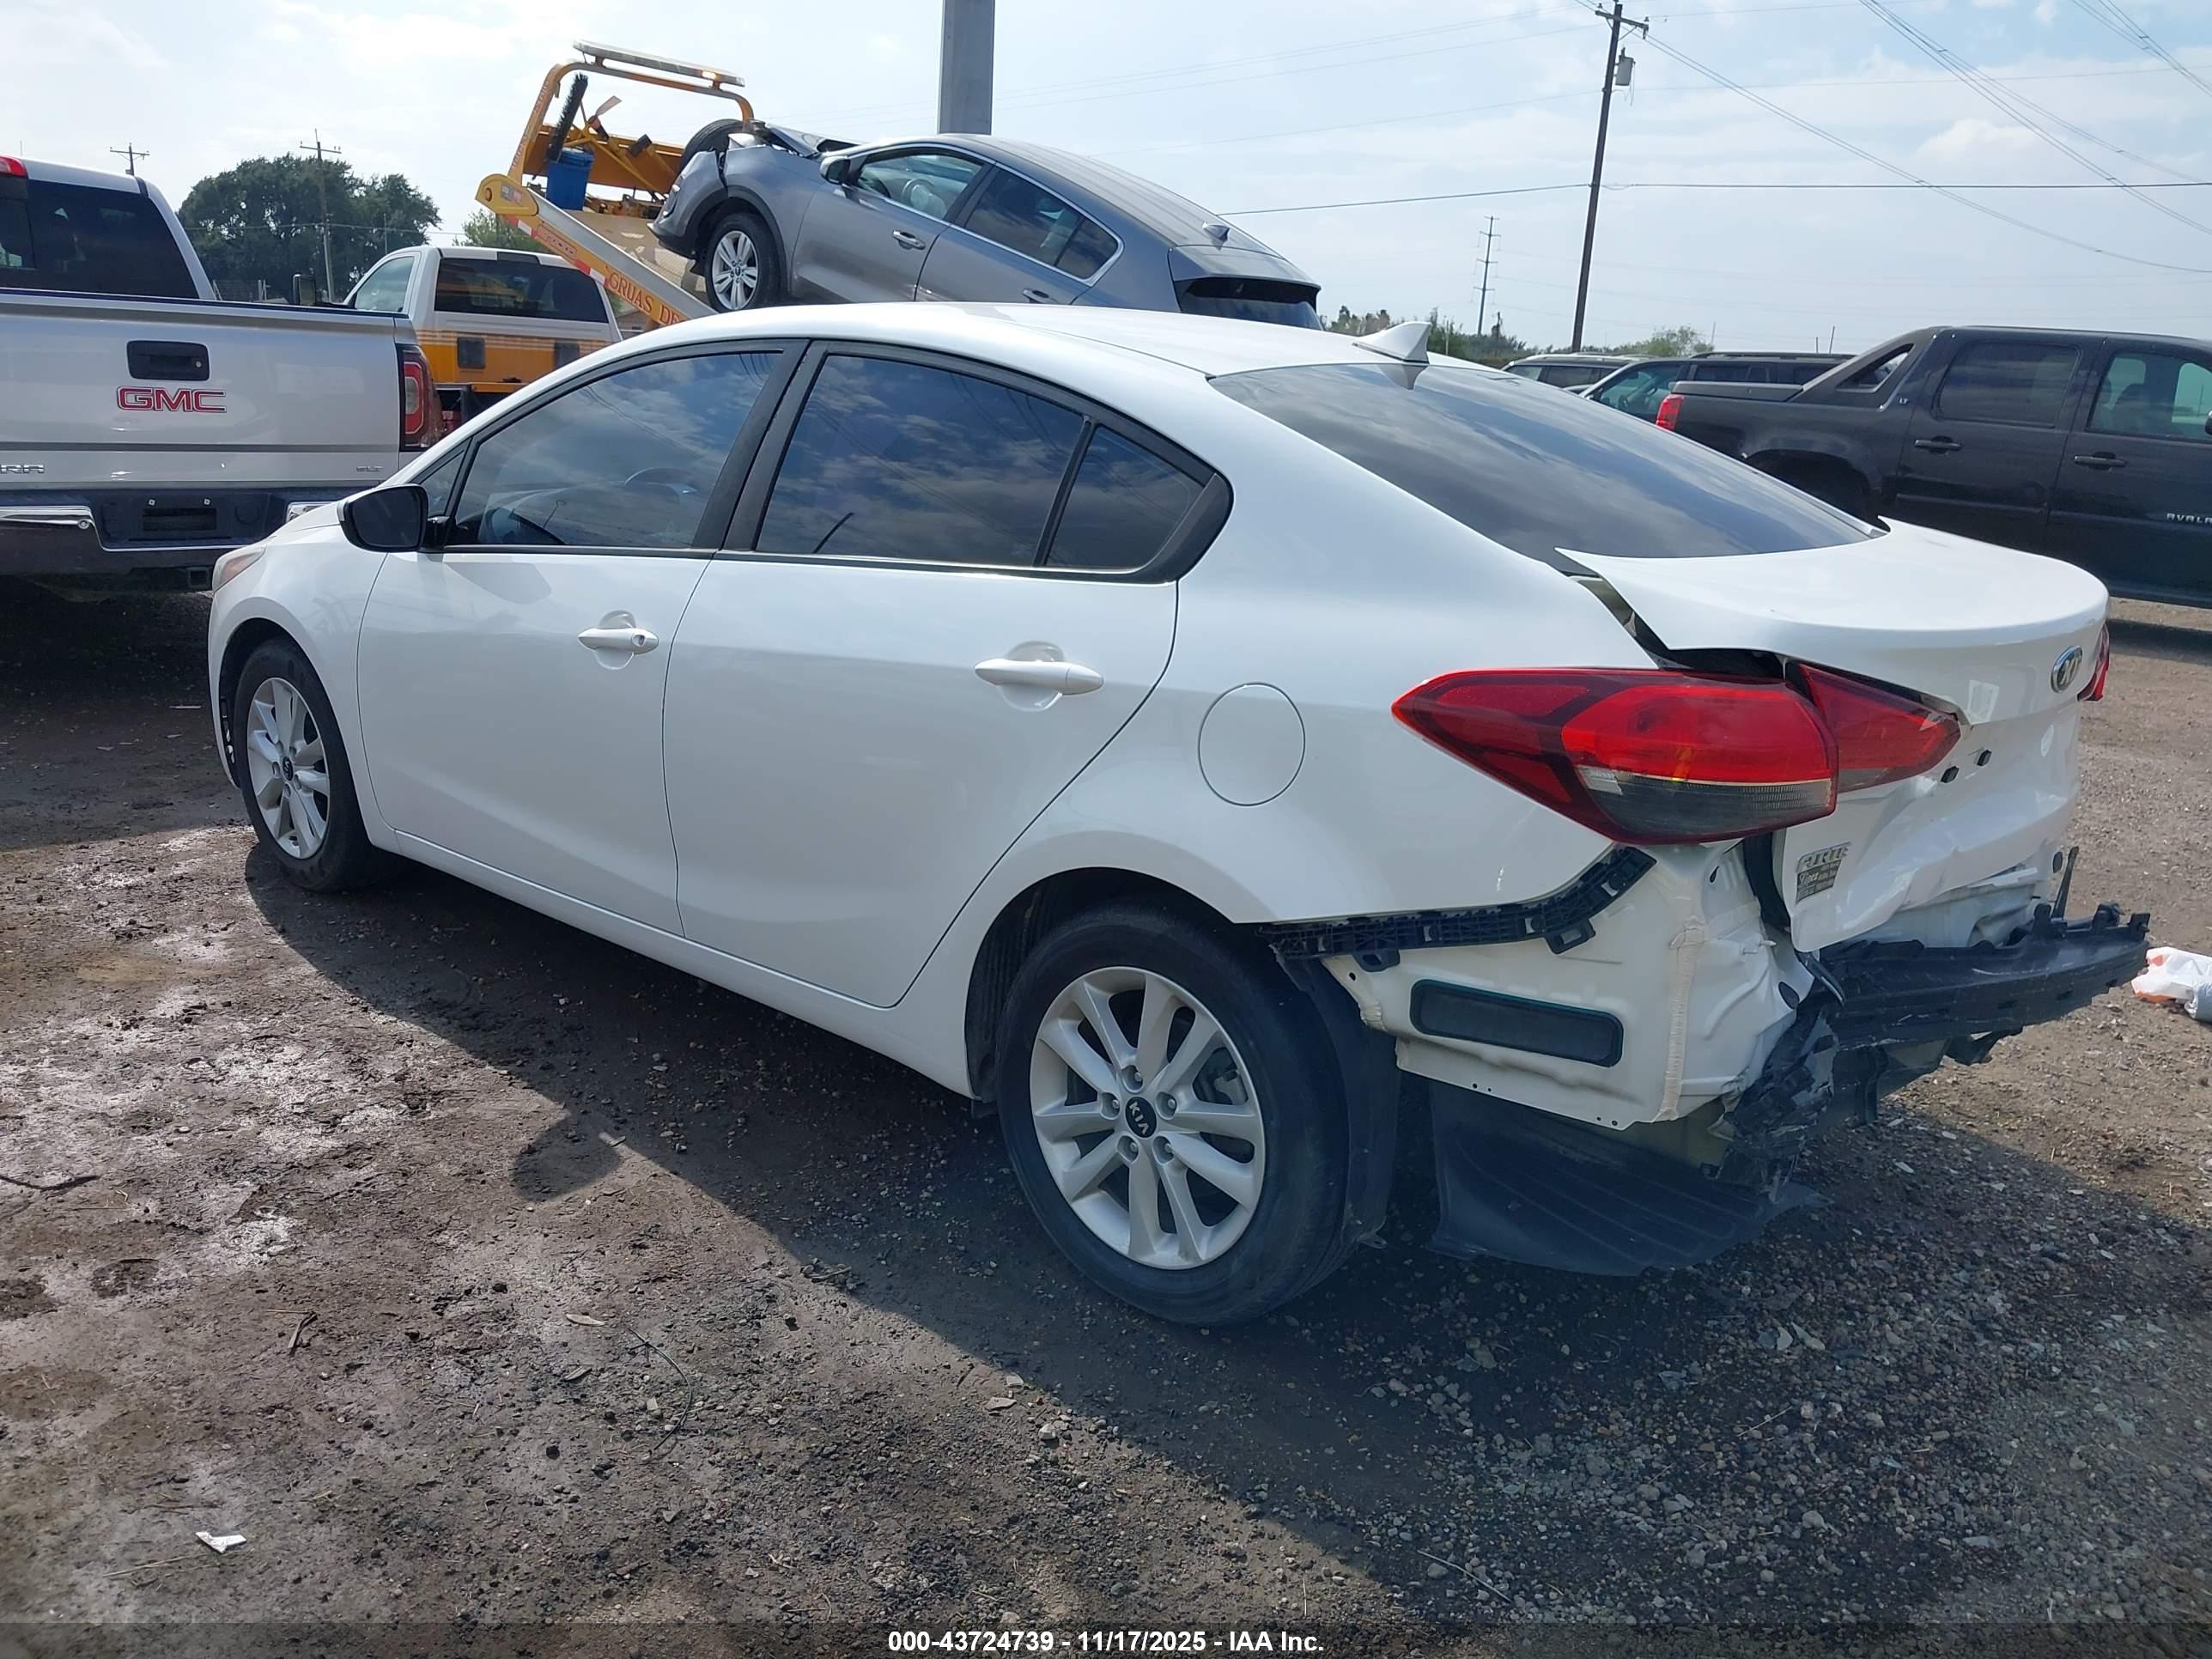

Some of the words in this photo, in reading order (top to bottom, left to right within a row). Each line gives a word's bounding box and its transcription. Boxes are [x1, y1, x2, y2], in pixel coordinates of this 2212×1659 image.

[609, 271, 653, 313] GRUAS
[117, 386, 227, 413] GMC
[1129, 1101, 1149, 1135] KIA
